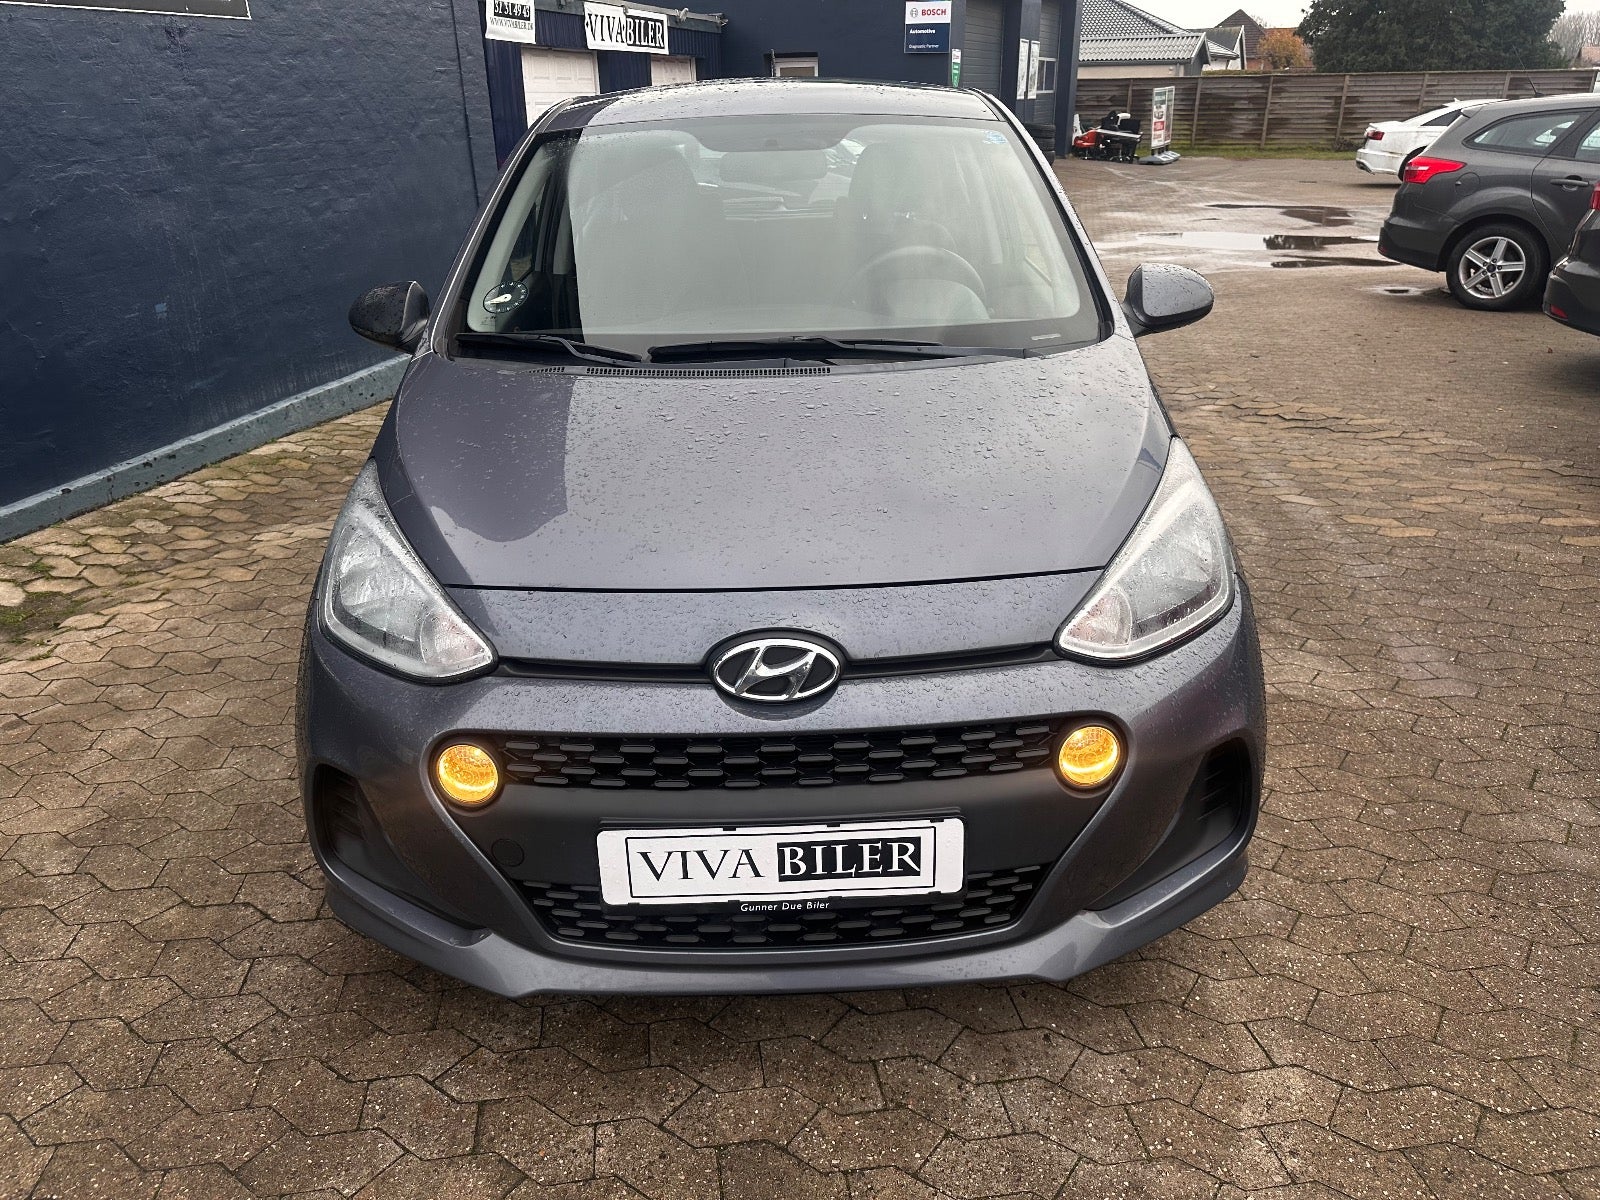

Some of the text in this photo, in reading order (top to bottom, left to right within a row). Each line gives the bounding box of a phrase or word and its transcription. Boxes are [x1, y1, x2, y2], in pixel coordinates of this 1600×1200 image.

[513, 4, 521, 16] 49
[522, 5, 530, 17] 43
[587, 13, 665, 47] VIVA BILER
[637, 842, 921, 881] VIVA BILER
[740, 901, 830, 912] Gunner Due Biler
